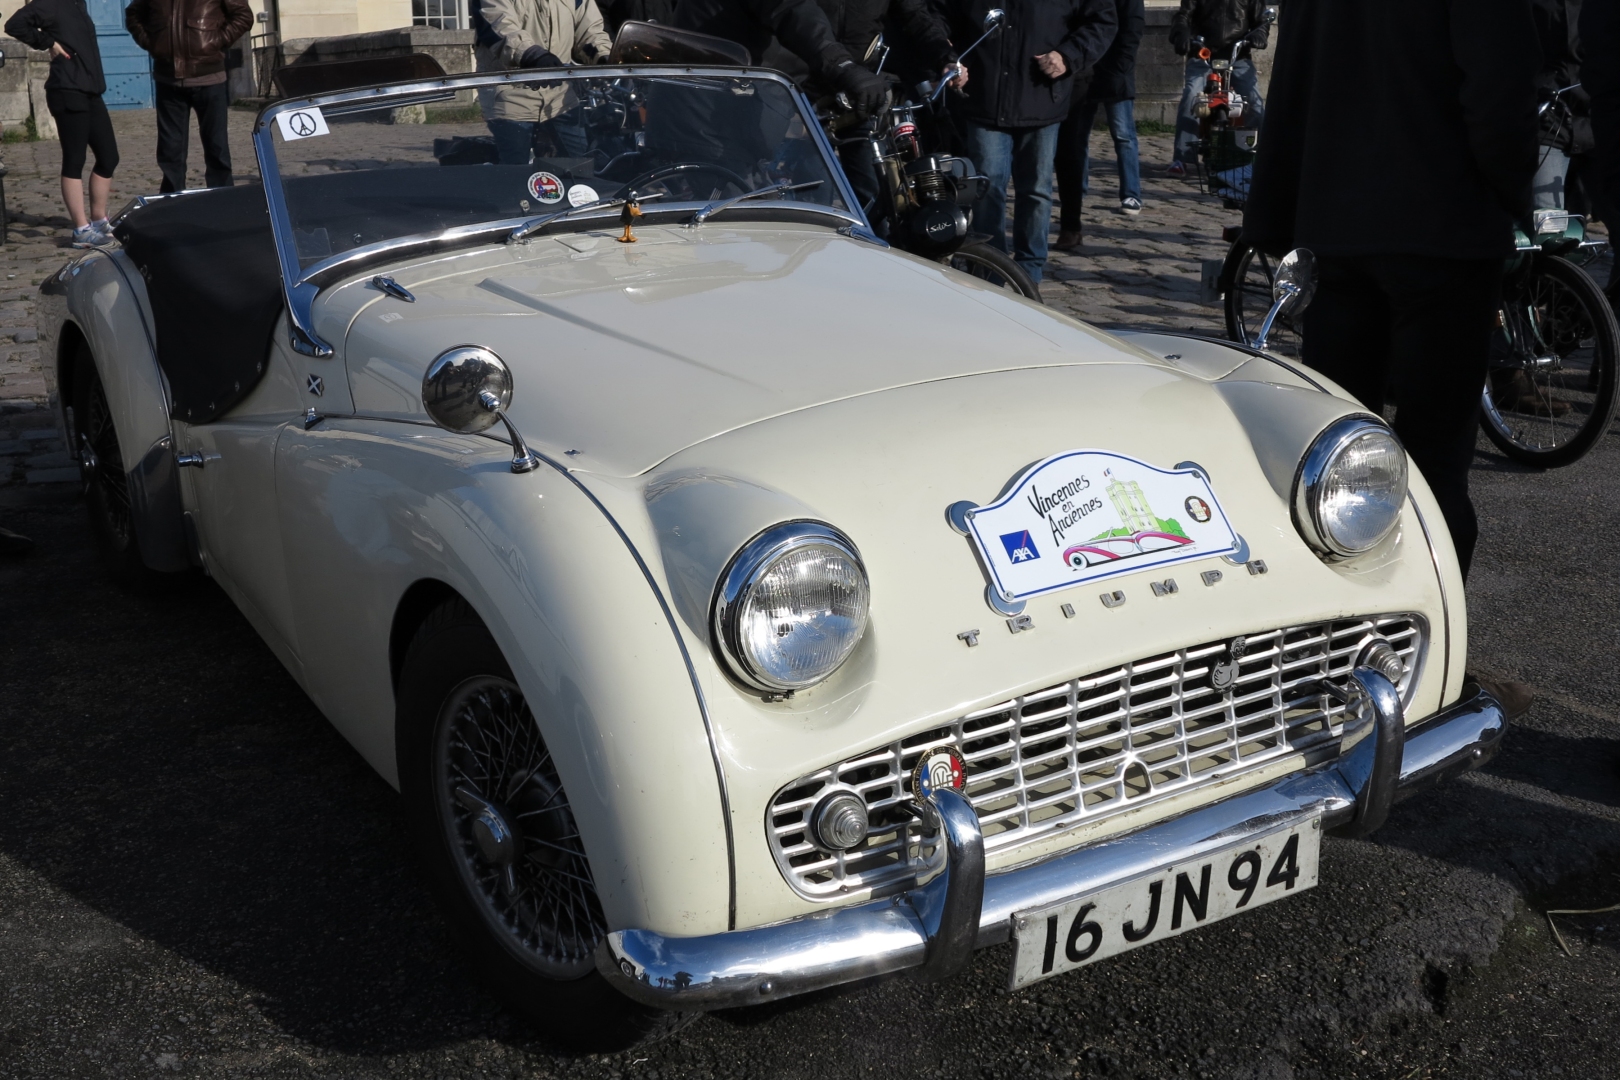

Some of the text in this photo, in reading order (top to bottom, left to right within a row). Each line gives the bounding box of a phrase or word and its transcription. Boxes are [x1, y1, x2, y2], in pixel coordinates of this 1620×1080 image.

[1027, 474, 1090, 519] Vincennes
[1062, 500, 1075, 514] en
[1048, 496, 1103, 547] Anciennes
[1011, 546, 1034, 564] AXA
[957, 559, 1268, 647] TRIUMPH
[1041, 833, 1300, 975] 16 JN 94
